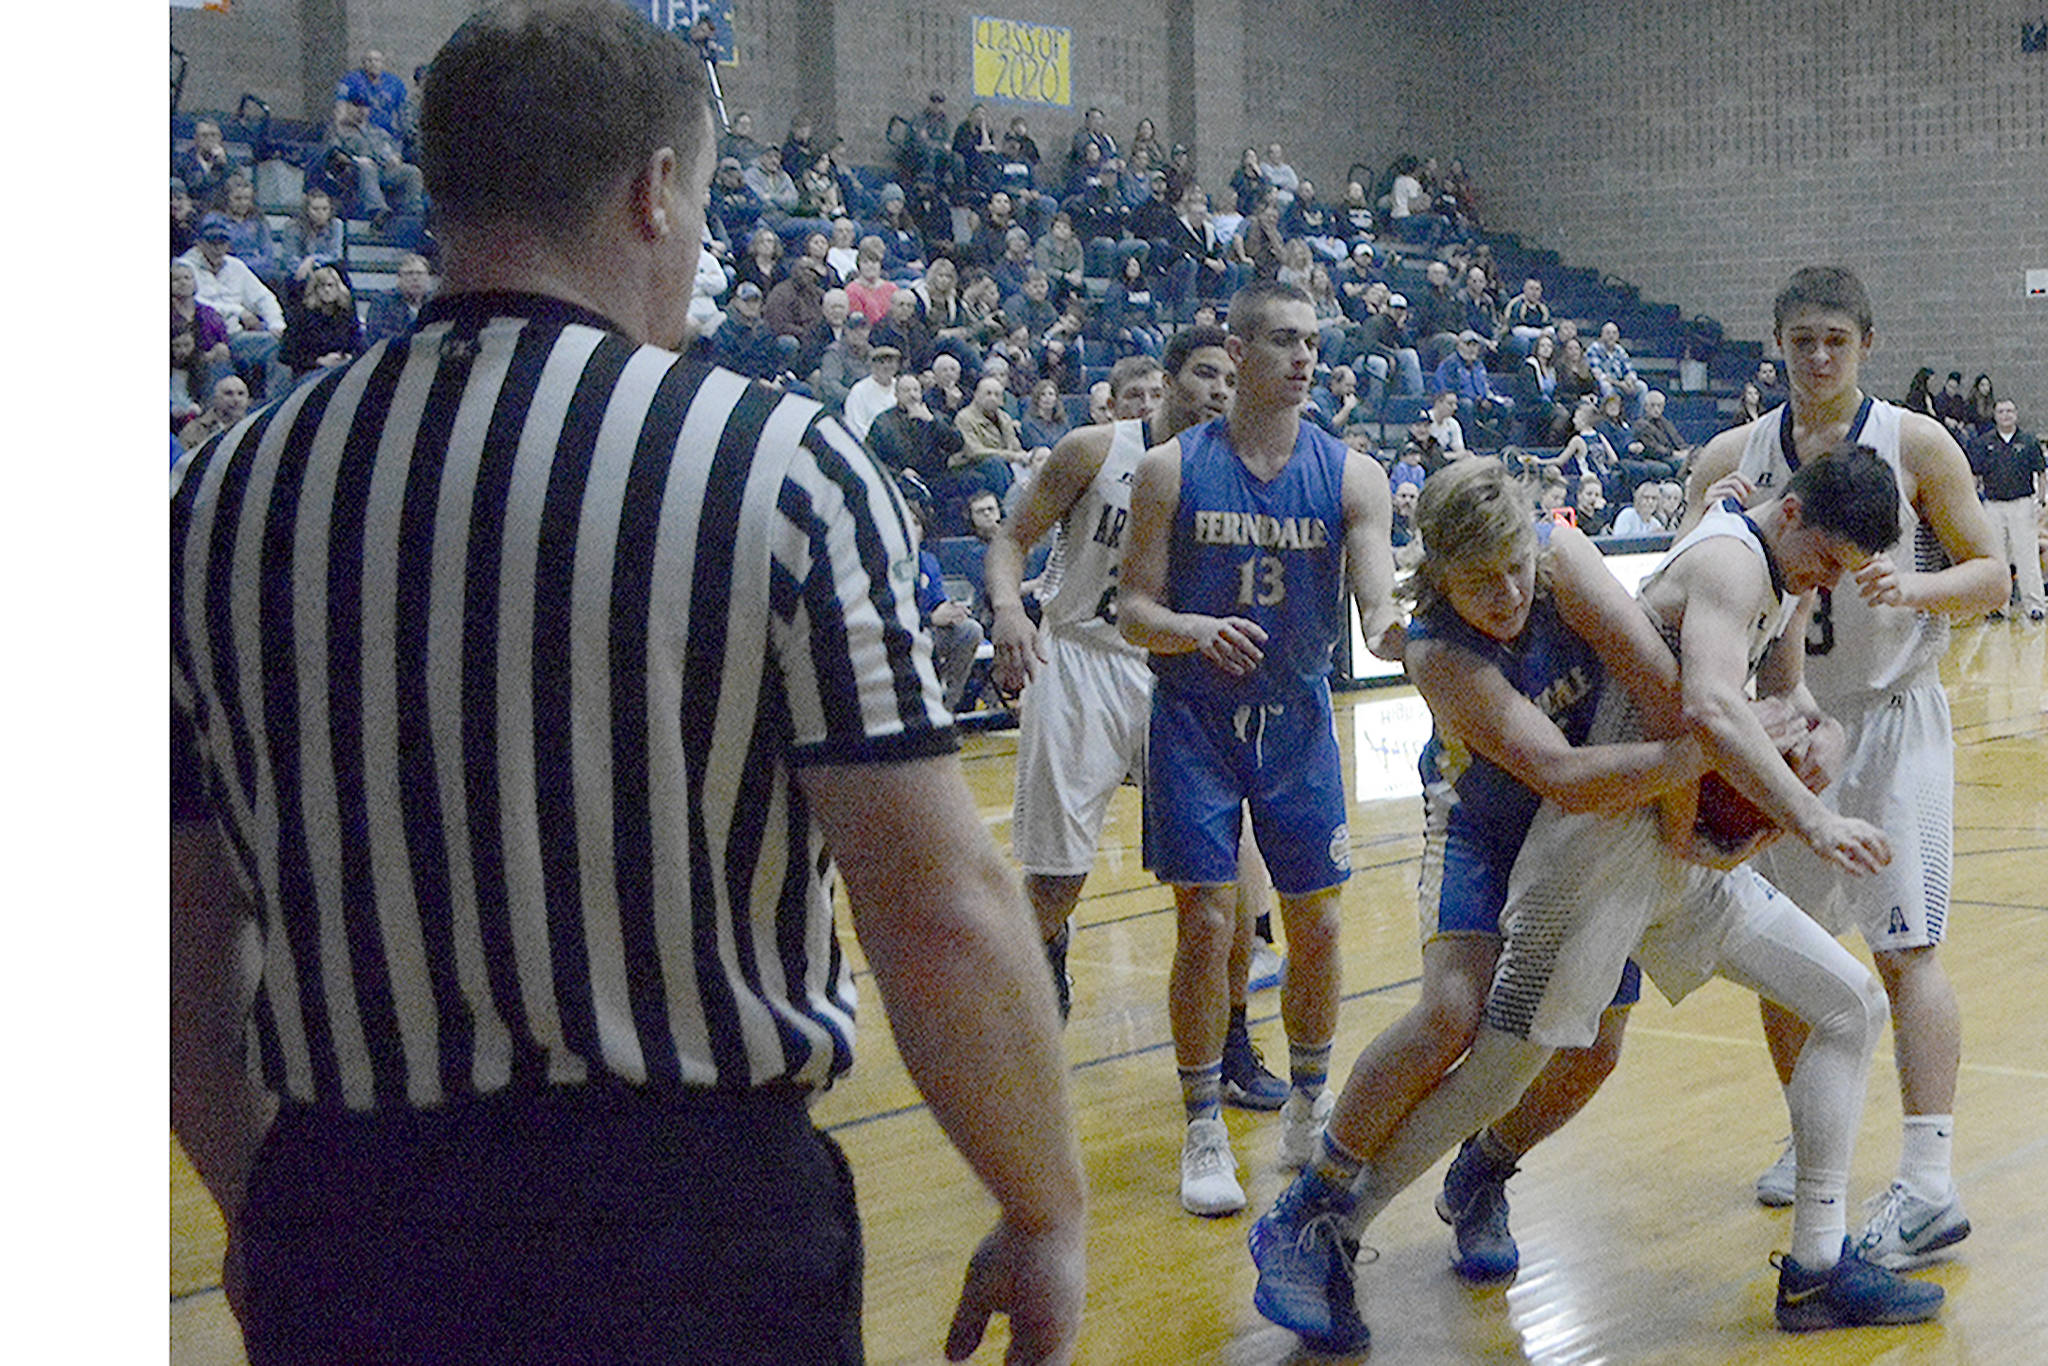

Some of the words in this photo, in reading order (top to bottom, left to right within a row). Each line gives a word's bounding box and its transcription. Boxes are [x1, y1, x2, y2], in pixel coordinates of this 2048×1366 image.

[993, 53, 1059, 102] 2020
[1194, 509, 1328, 550] FERNDALE
[1237, 554, 1286, 606] 13
